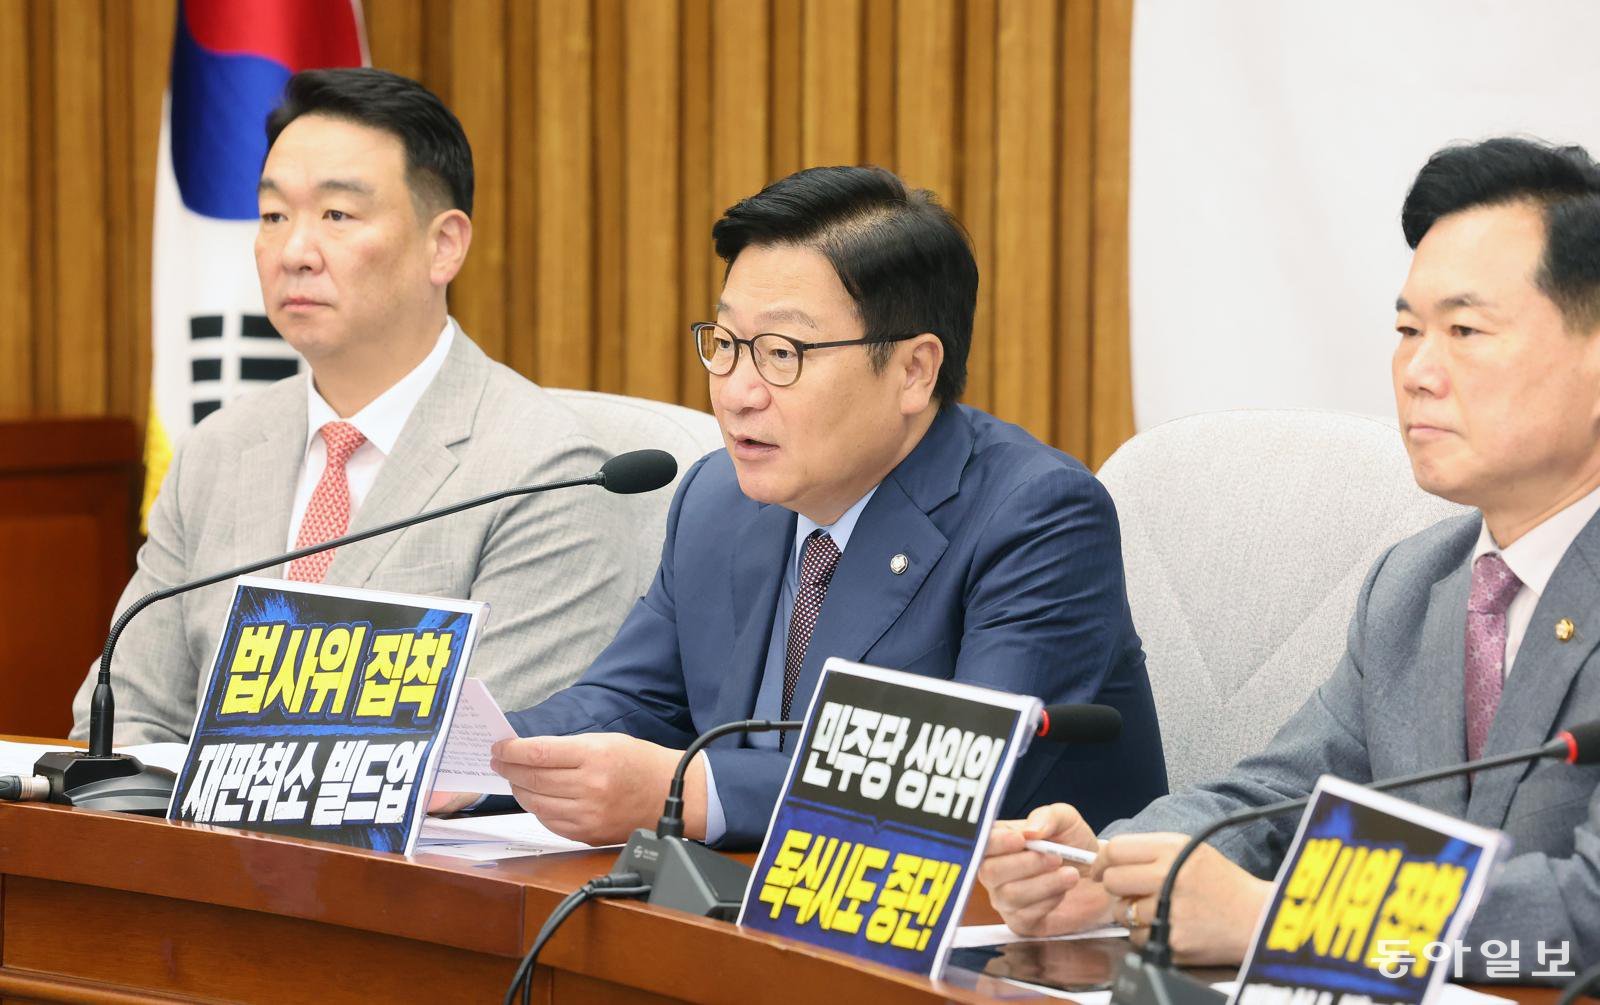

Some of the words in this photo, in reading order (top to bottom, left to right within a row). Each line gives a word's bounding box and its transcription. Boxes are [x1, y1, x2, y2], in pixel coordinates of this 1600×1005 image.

[221, 624, 367, 714] 법사위
[356, 633, 452, 717] 집착
[181, 740, 319, 822] 재판취소
[310, 740, 429, 826] 빌드업
[802, 701, 911, 800] 민주당
[895, 722, 1006, 824] 상임위
[759, 829, 890, 934] 독식시도
[865, 852, 962, 952] 중단!
[1266, 838, 1402, 962] 법사위
